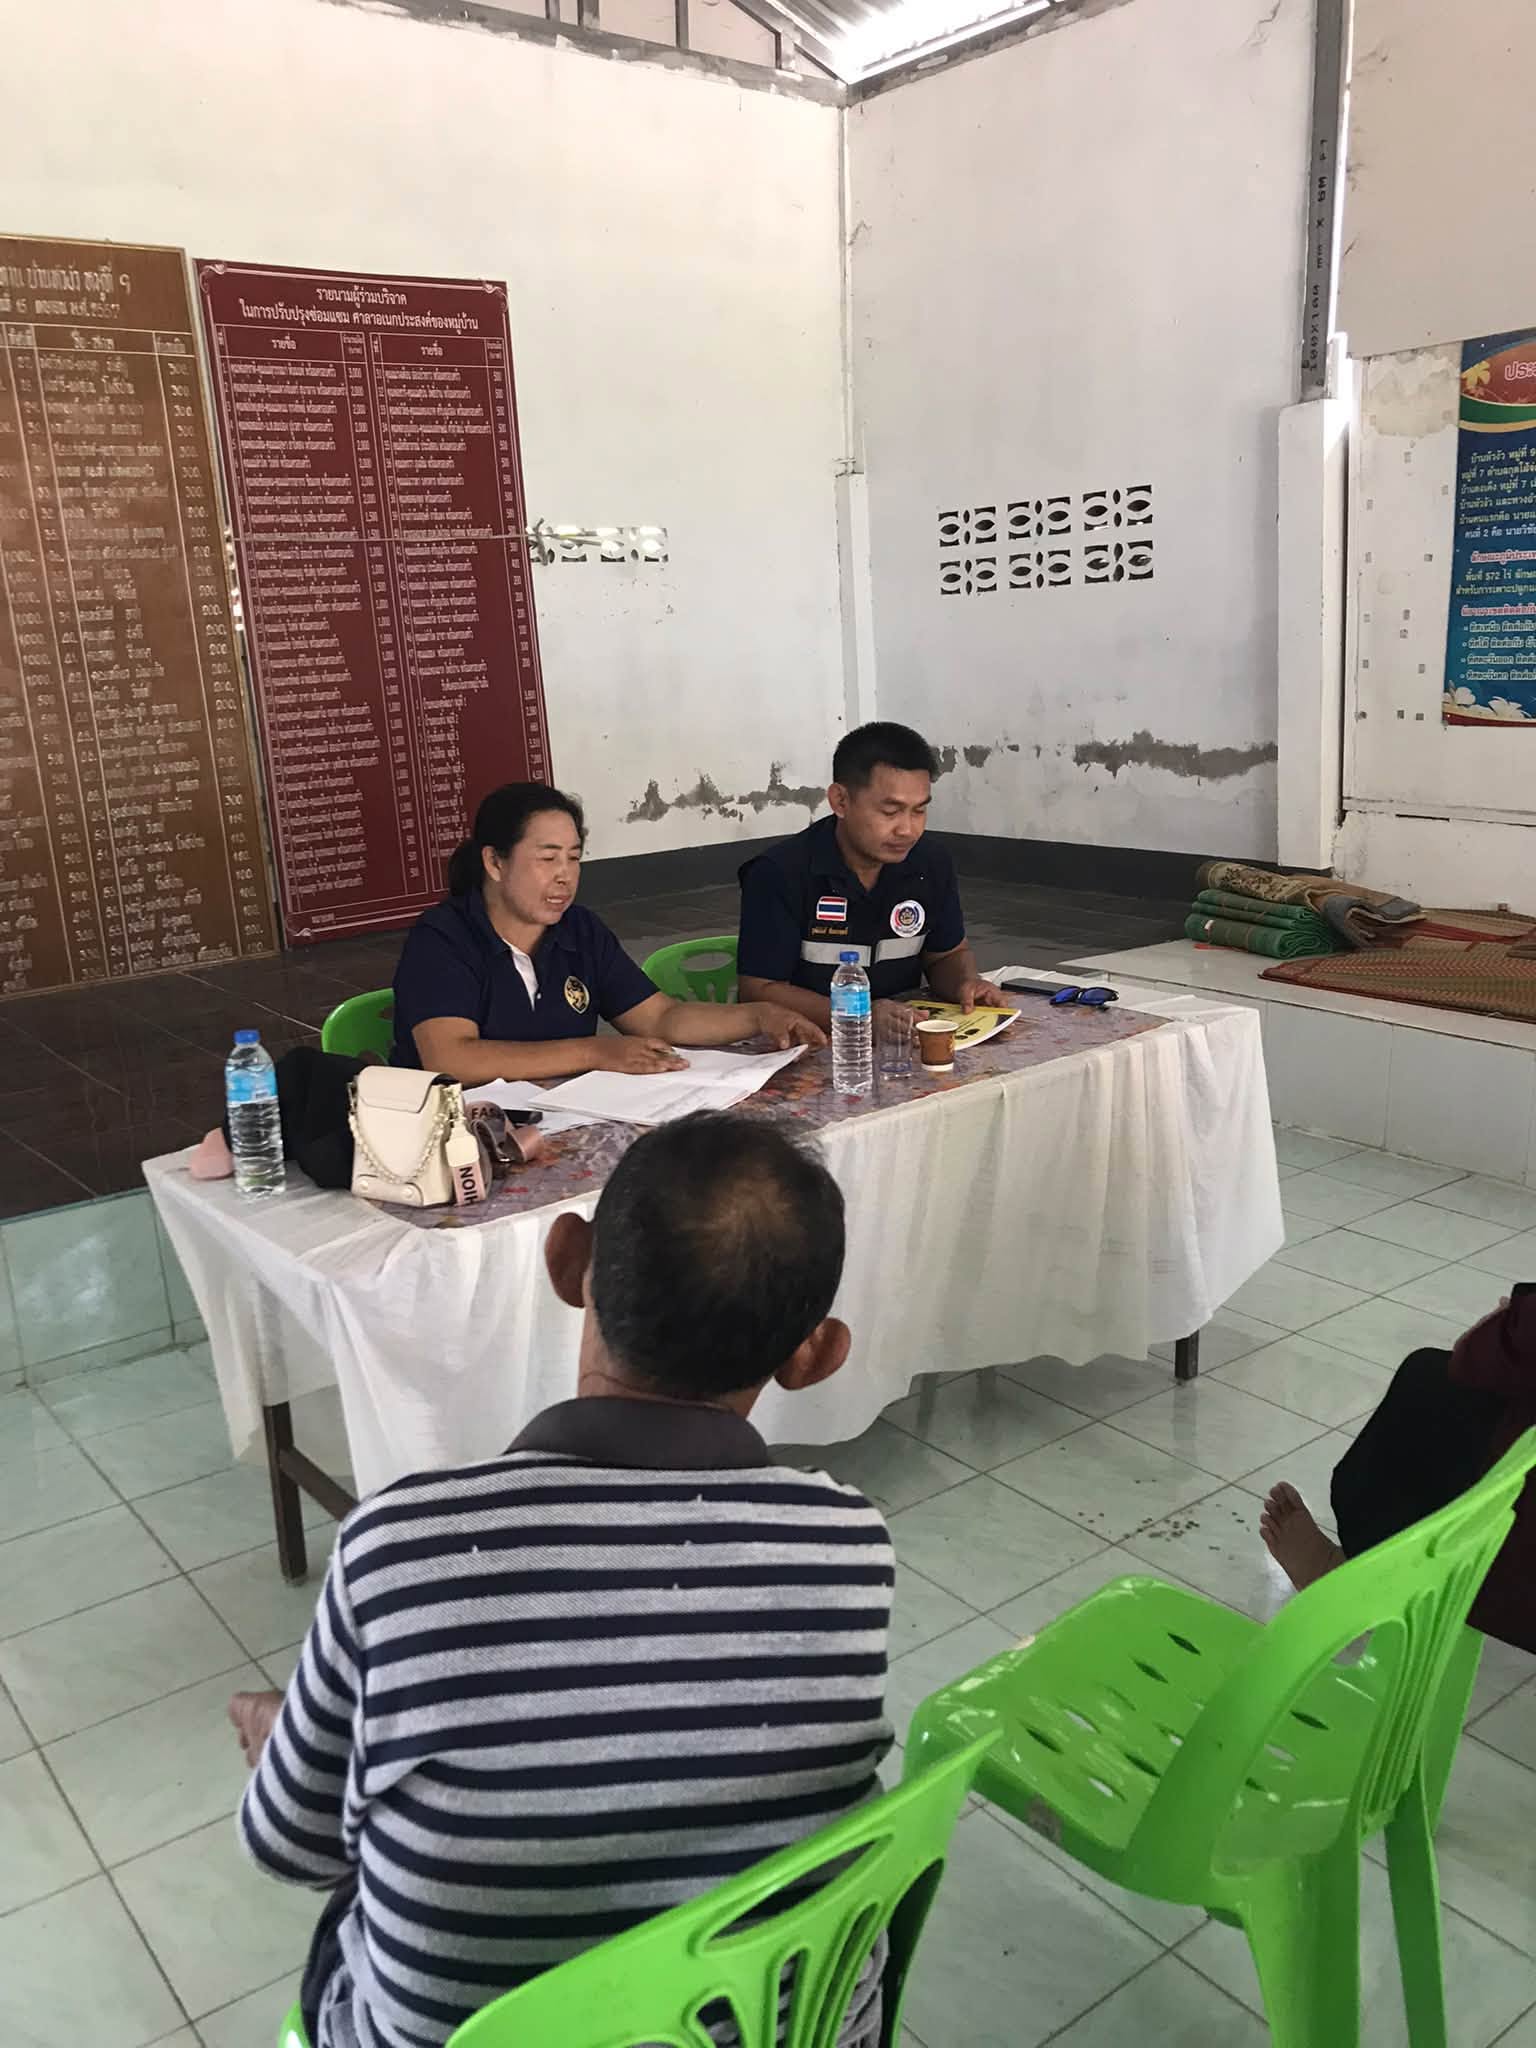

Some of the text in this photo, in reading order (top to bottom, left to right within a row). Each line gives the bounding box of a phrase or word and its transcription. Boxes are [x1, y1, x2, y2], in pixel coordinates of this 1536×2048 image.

[316, 285, 407, 309] รายนามผู้ร่วมบริจาค
[1504, 360, 1536, 381] ประ
[1483, 528, 1489, 538] 2
